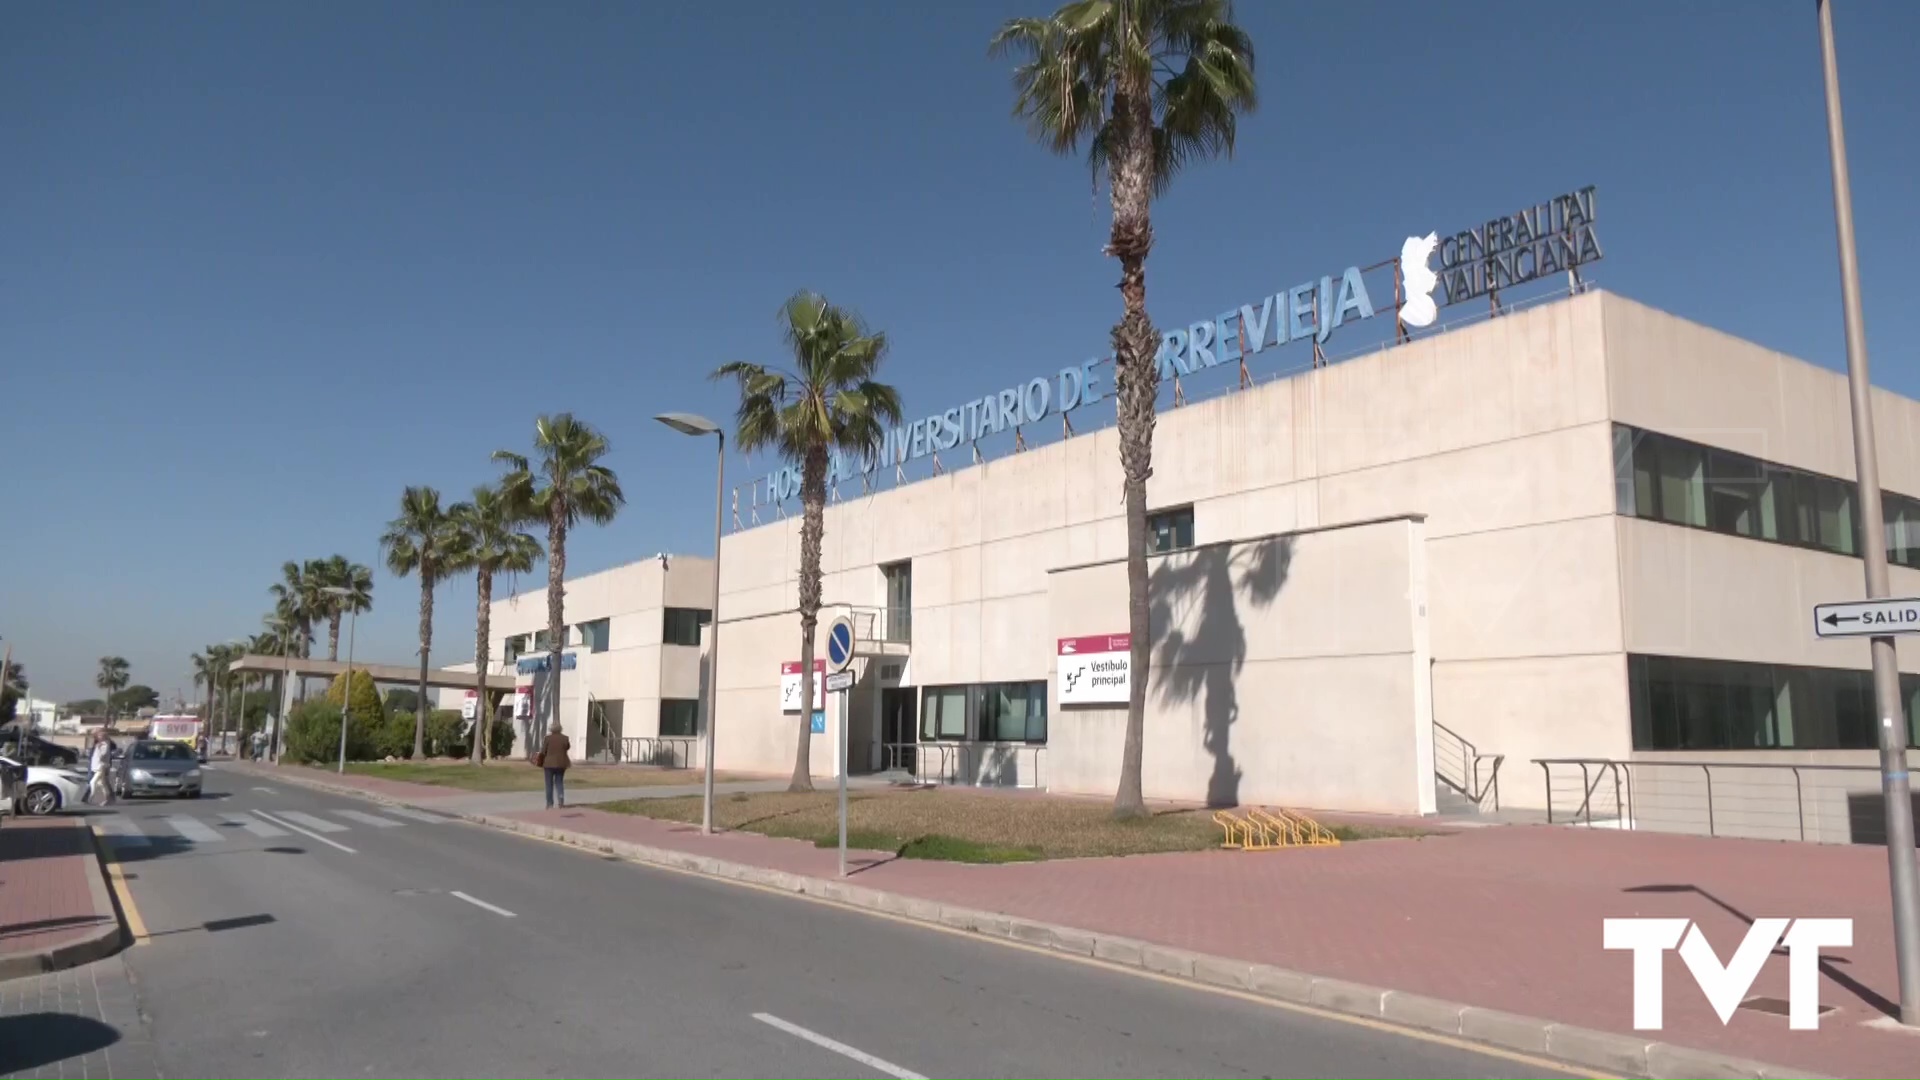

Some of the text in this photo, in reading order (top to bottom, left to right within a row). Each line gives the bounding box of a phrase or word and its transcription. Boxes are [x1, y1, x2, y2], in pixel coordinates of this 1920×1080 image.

[1440, 184, 1596, 270] GENERALITAT
[1441, 225, 1603, 307] VALENCIANA
[766, 447, 853, 505] HOSAL
[1059, 357, 1101, 413] DE
[1113, 265, 1374, 384] RREVIEJA
[1862, 608, 1920, 625] SALID
[1091, 659, 1128, 673] Vestíbulo
[1091, 673, 1126, 688] principal
